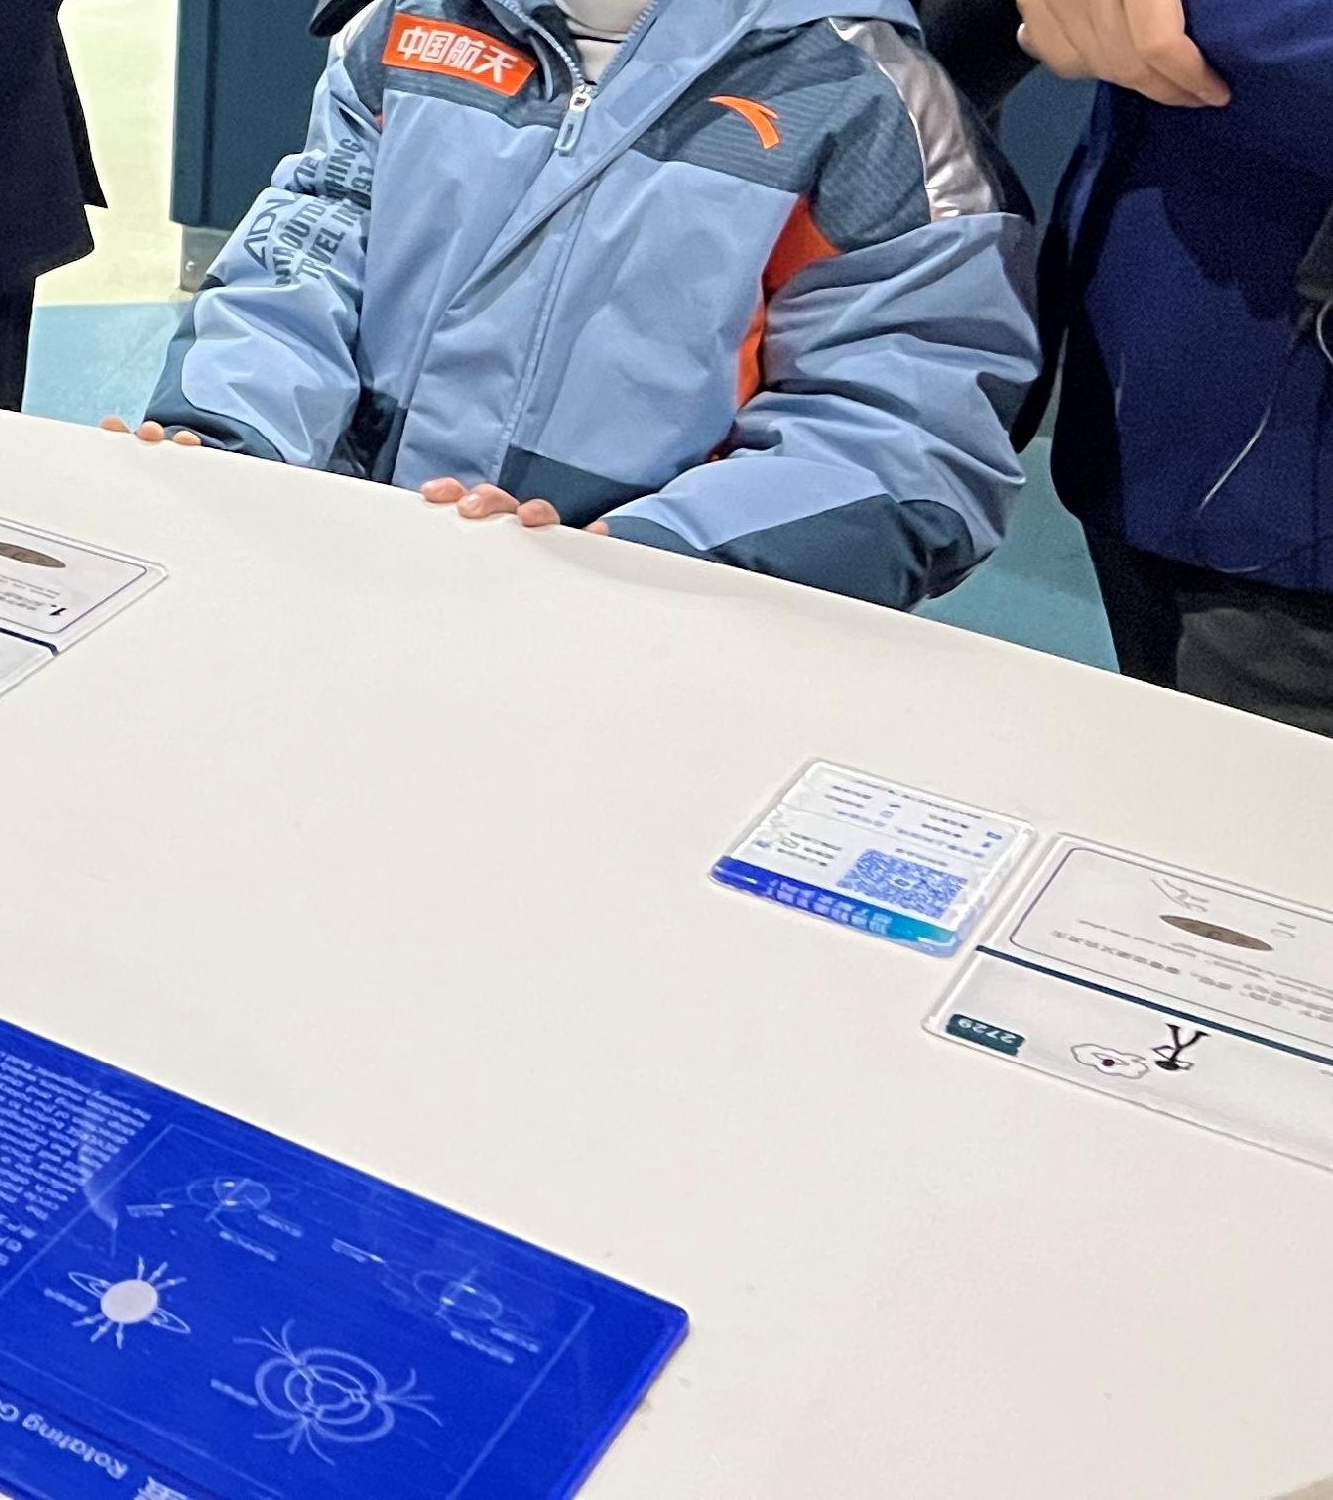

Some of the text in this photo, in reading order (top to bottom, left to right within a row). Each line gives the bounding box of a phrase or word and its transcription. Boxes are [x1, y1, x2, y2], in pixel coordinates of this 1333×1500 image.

[396, 24, 519, 85] 中国航天
[958, 1018, 1015, 1044] 2729
[21, 1411, 129, 1480] Rotating
